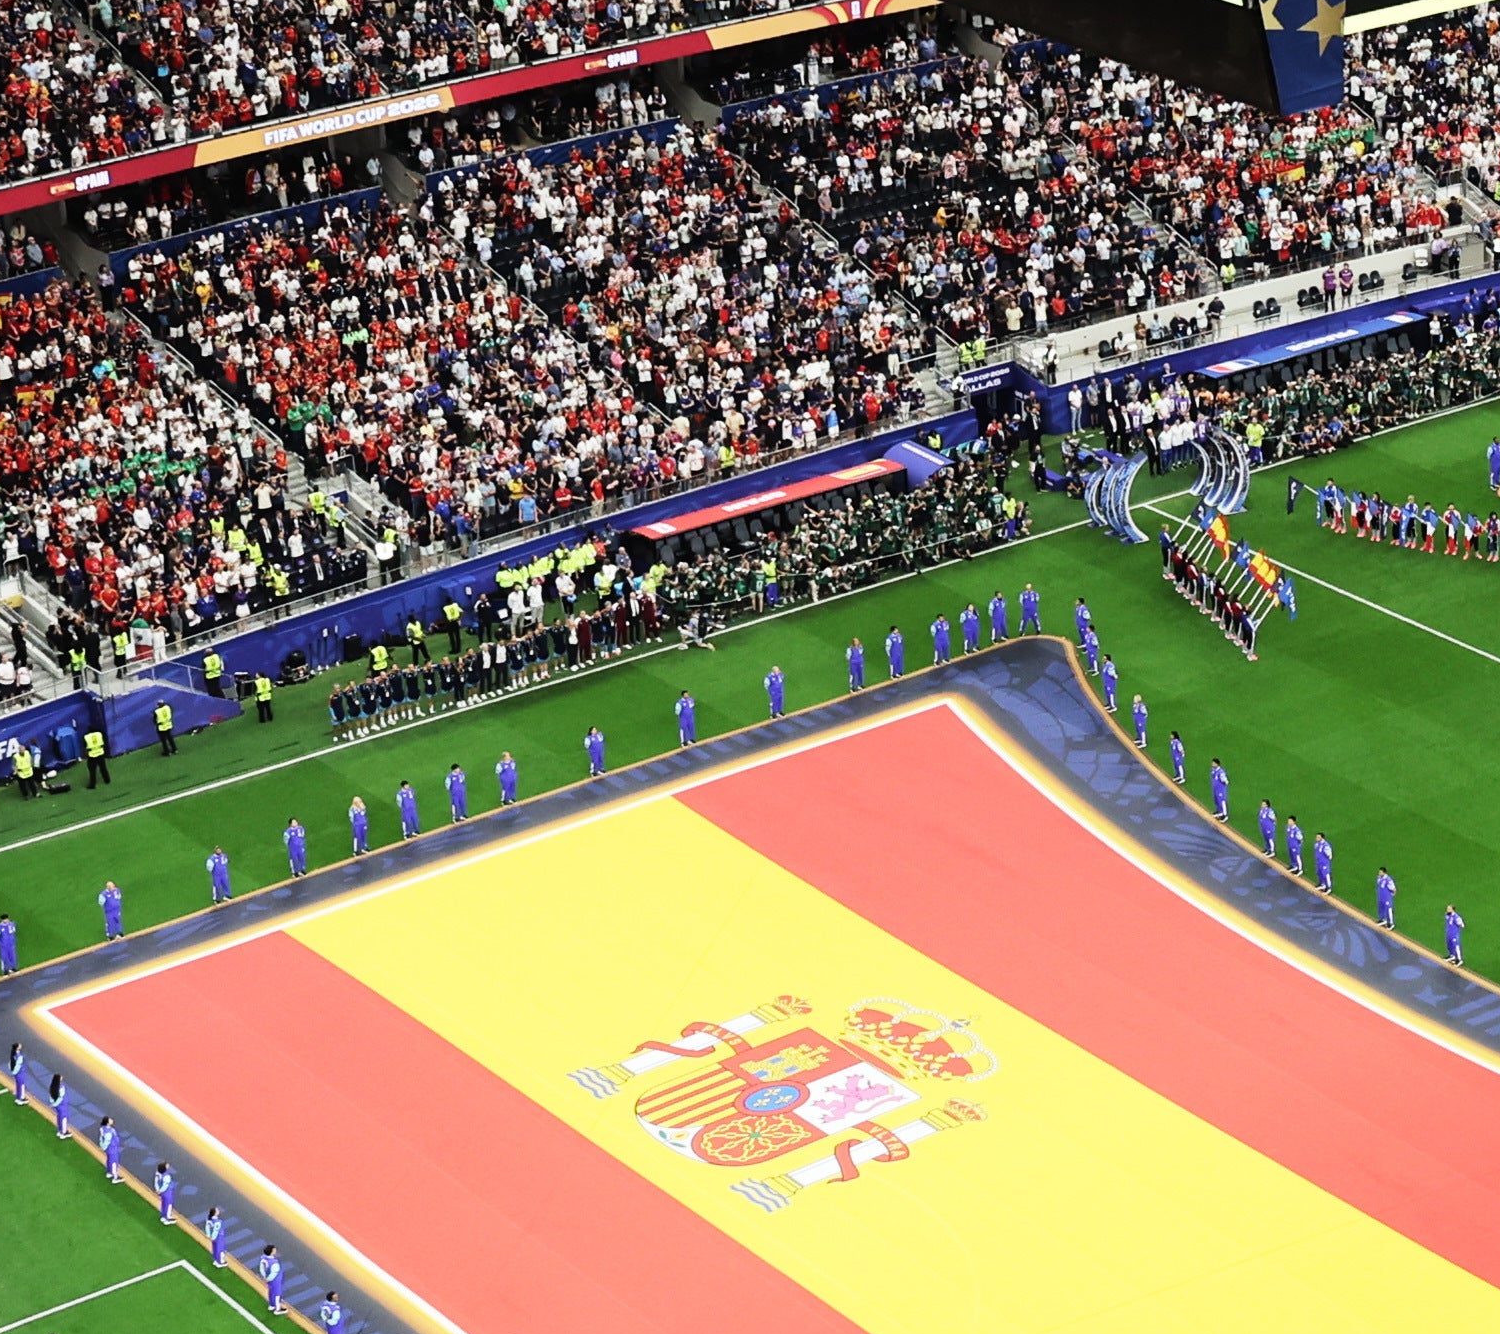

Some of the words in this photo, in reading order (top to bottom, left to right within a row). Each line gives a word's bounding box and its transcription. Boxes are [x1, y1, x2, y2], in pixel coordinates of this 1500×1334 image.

[607, 49, 638, 69] SPAIN
[264, 126, 298, 146] FIFA
[298, 114, 355, 137] WORLD
[355, 105, 386, 124] CUP
[386, 94, 441, 118] 2026
[75, 170, 111, 192] SPAIN
